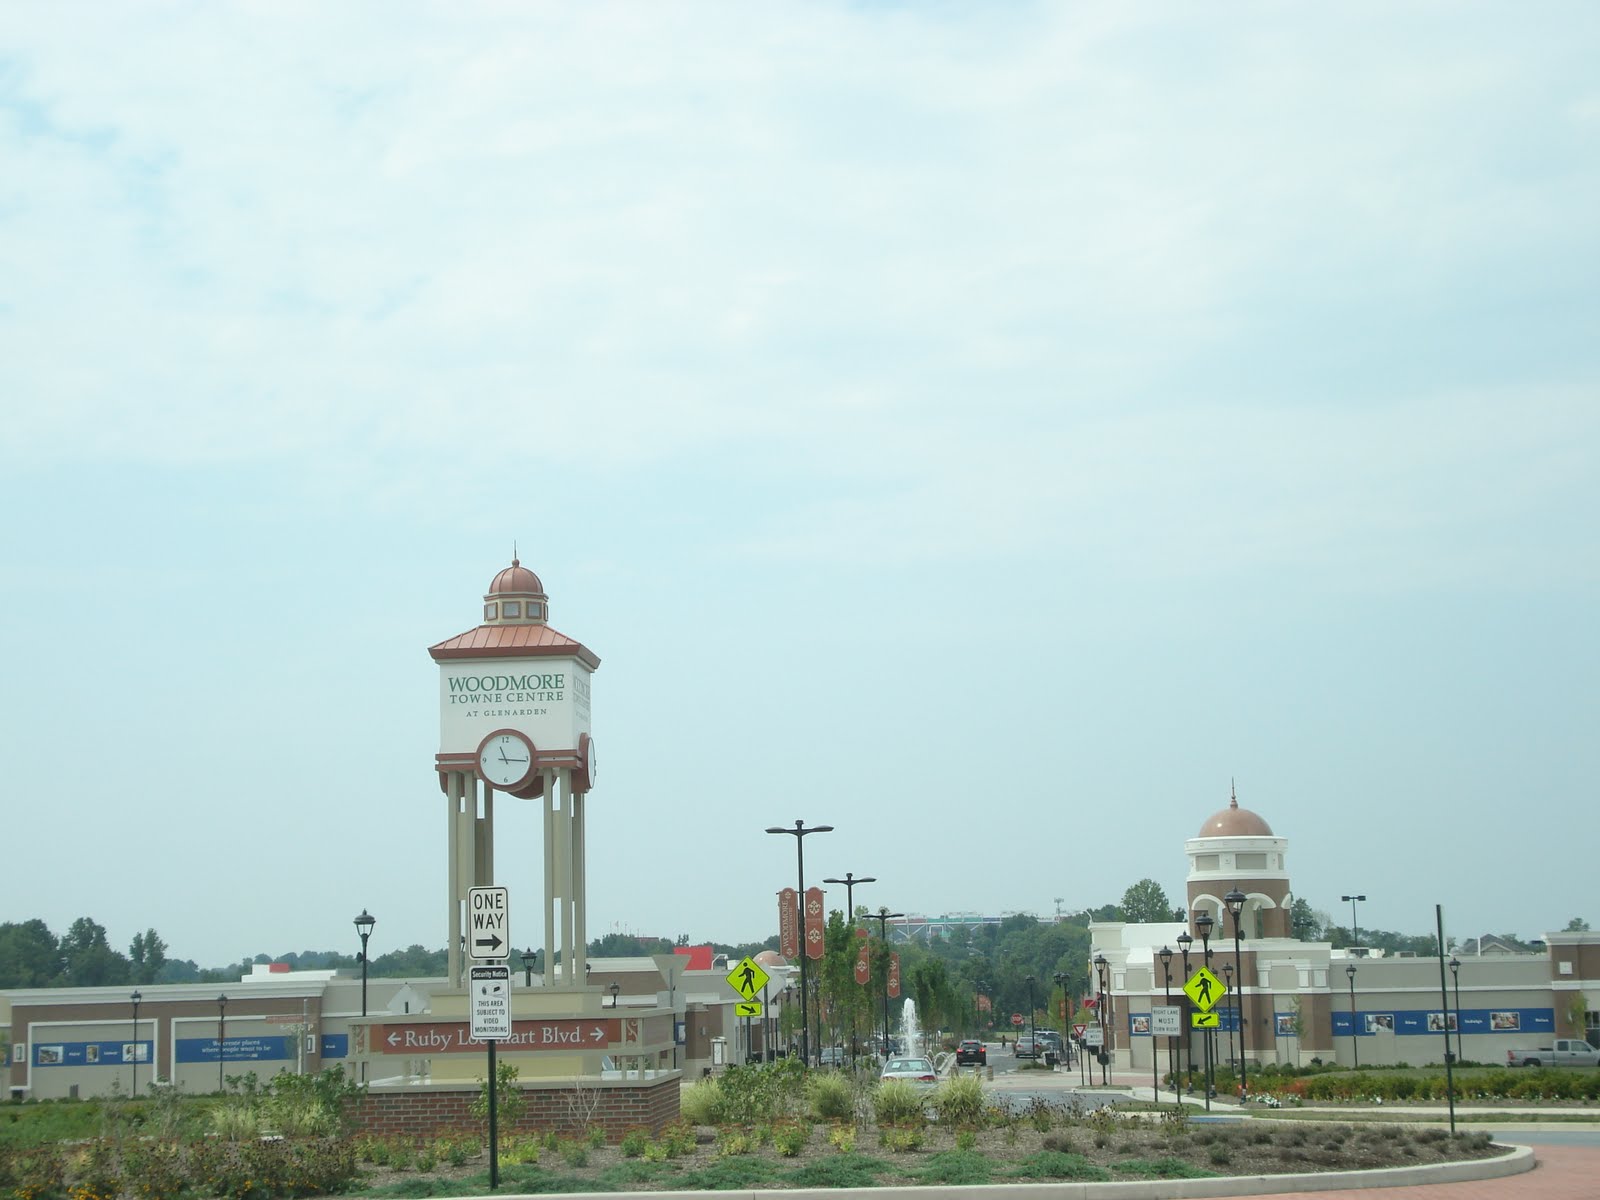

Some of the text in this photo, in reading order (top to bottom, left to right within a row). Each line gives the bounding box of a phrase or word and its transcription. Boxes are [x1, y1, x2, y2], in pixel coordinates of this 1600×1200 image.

[448, 674, 565, 692] WOODMORE
[449, 691, 564, 704] TOWNE CENTRE
[484, 708, 547, 717] GLENARDEN
[474, 893, 504, 910] ONE
[473, 912, 504, 929] WAY
[781, 900, 789, 947] WOODMORE
[472, 970, 507, 979] Security Notice
[404, 1030, 452, 1051] Ruby
[542, 1026, 585, 1043] Blvd.
